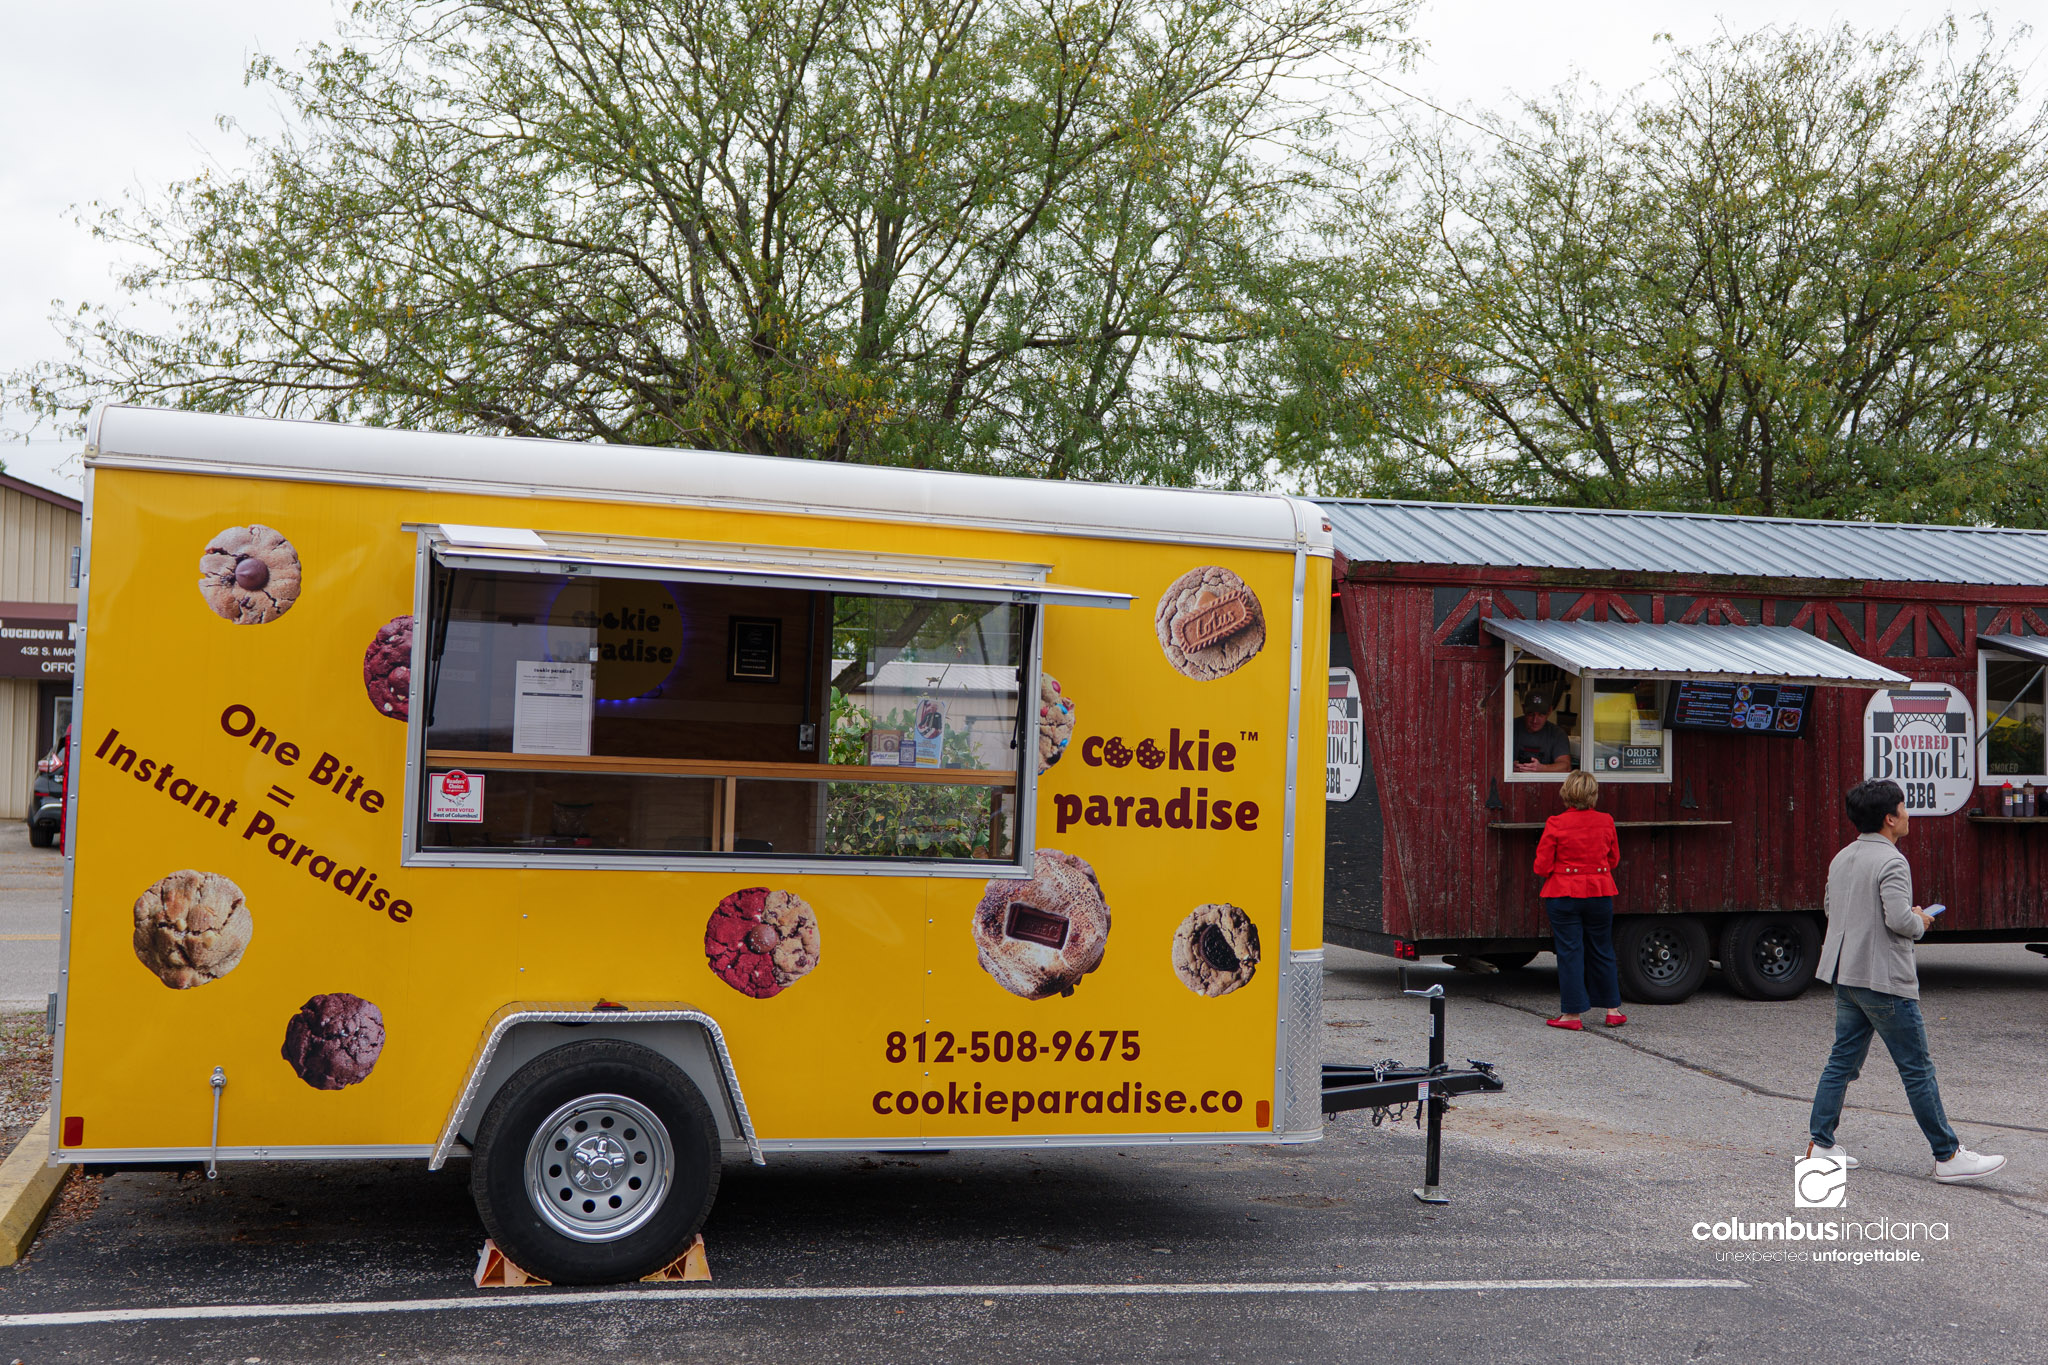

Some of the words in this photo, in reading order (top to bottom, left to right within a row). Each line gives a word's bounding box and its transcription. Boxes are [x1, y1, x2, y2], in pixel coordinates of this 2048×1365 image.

[0, 621, 63, 640] OUCHDOWN
[1196, 609, 1235, 640] Lotus
[20, 646, 39, 656] 432
[41, 646, 51, 656] S.
[1626, 748, 1658, 757] ORDER
[1871, 736, 1968, 779] BRIDGE
[1894, 735, 1948, 750] COVERED
[221, 704, 301, 766] One
[308, 752, 385, 814] Bite
[1990, 762, 2019, 773] SMOKED
[1053, 787, 1260, 834] paradise
[1906, 782, 1936, 809] BBQ
[95, 728, 238, 828] Instant
[242, 810, 414, 923] Paradise
[885, 1030, 1141, 1063] 812-508-9675
[872, 1081, 1243, 1122] cookieparadise.co
